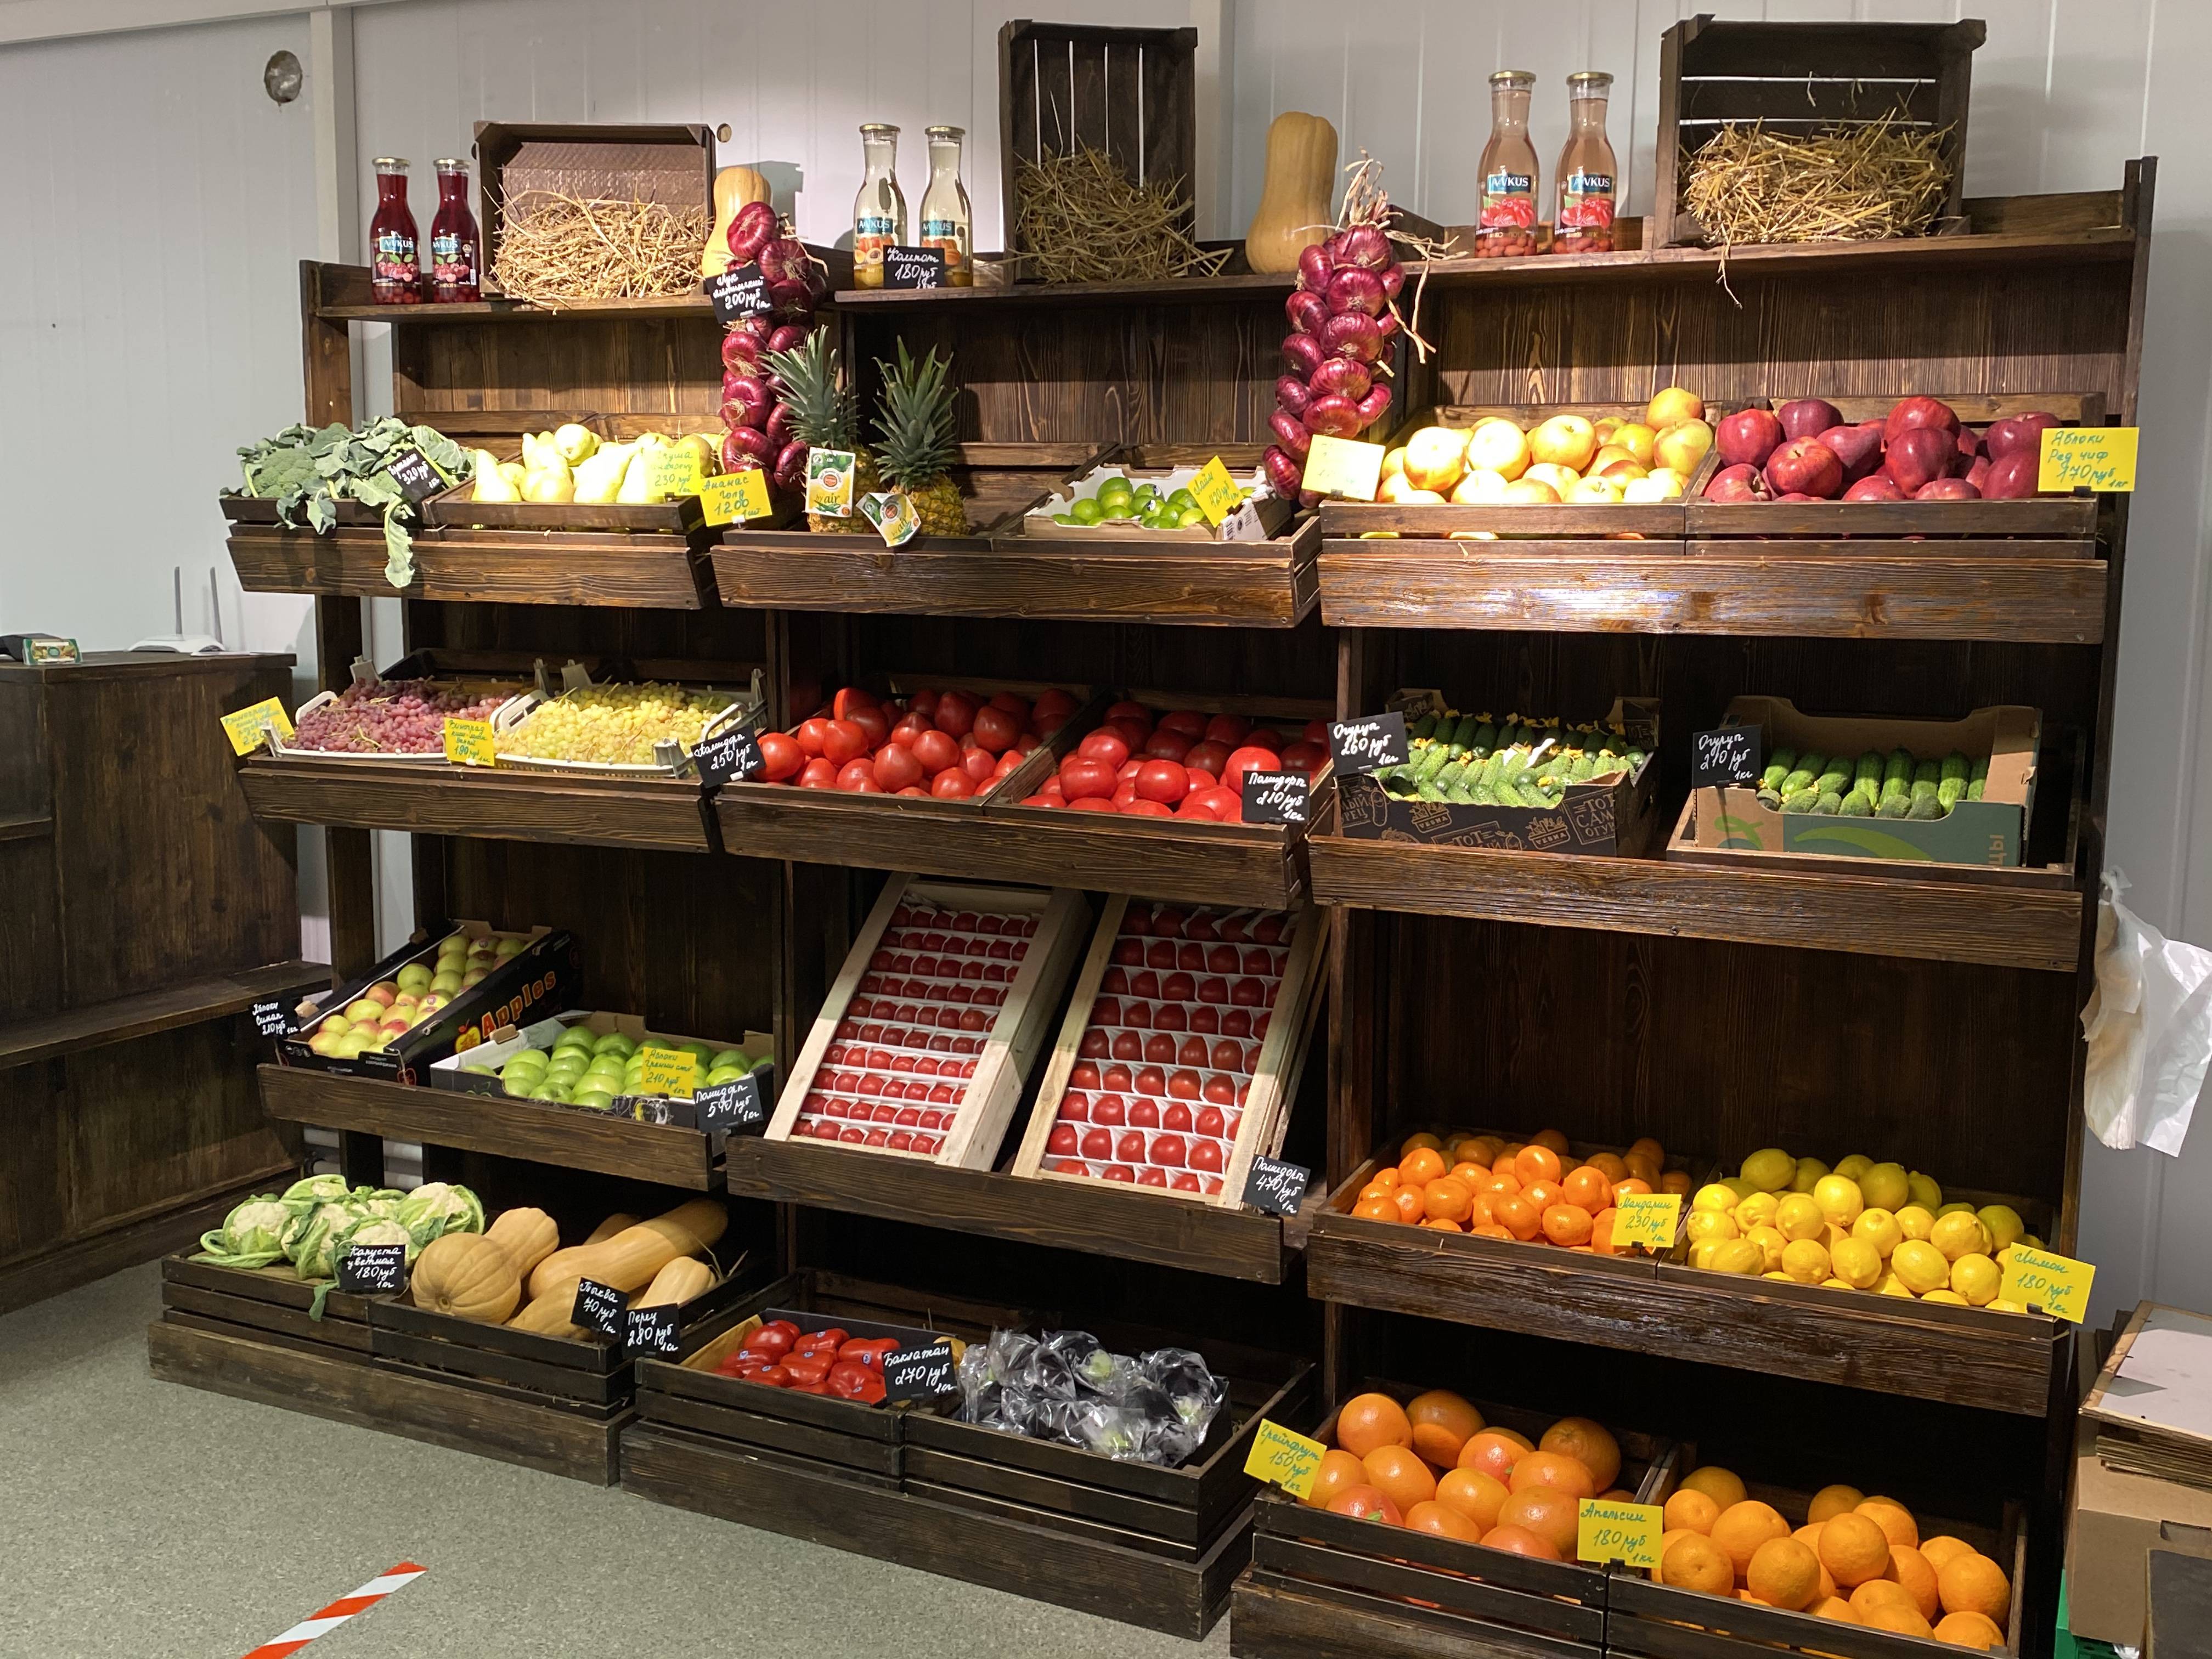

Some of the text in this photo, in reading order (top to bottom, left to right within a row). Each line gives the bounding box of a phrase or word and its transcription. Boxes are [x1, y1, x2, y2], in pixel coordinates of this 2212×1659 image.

[887, 247, 939, 262] Компот
[716, 273, 739, 287] Лук
[895, 263, 939, 285] 180 руб
[725, 289, 761, 310] 200 руб
[2051, 430, 2106, 446] Яблоки
[2047, 448, 2073, 465] Ред
[402, 460, 428, 485] 320 руб
[654, 473, 676, 487] 230
[2056, 464, 2117, 486] 170 руб
[702, 476, 750, 492] Ананас
[1193, 471, 1214, 495] Лайм
[2108, 479, 2128, 489] 1кг
[824, 493, 840, 504] air
[1209, 487, 1222, 508] 420
[714, 499, 750, 516] 1200
[449, 719, 485, 735] Виноград
[454, 744, 469, 755] 190
[1340, 733, 1392, 758] 260 руб
[710, 743, 752, 770] 250 руб
[1700, 748, 1751, 771] 210 руб
[1734, 770, 1753, 780] 1кг
[1278, 794, 1305, 811] руб
[1583, 793, 1615, 812] ТОТ
[1341, 808, 1368, 825] РЕЦ
[252, 1002, 279, 1016] Яблоки
[482, 970, 556, 1040] Apples
[275, 1020, 286, 1035] руб
[648, 1049, 679, 1060] Яблоки
[733, 1095, 752, 1115] руб
[1256, 1173, 1302, 1203] 470 руб
[1617, 1196, 1673, 1217] Мандарин
[1625, 1215, 1668, 1233] 230 руб
[349, 1245, 402, 1256] Капуста
[347, 1255, 396, 1270] цветная
[2014, 1249, 2069, 1274] Лимон
[355, 1266, 398, 1281] 180 руб
[579, 1282, 619, 1304] Тыква
[2017, 1273, 2074, 1301] 180 руб
[583, 1297, 618, 1322] 70 руб
[2047, 1300, 2070, 1314] 1кг
[602, 1321, 617, 1334] 1кг
[628, 1311, 658, 1329] Перец
[627, 1323, 674, 1347] 280 руб
[895, 1362, 950, 1387] 270 руб
[1261, 1424, 1321, 1462] Грейпфрут
[1269, 1451, 1312, 1479] 150 руб
[1283, 1479, 1301, 1492] 1кг
[1581, 1502, 1647, 1522] Апельсин
[1593, 1529, 1647, 1553] 180 руб
[1632, 1553, 1655, 1563] 1кг
